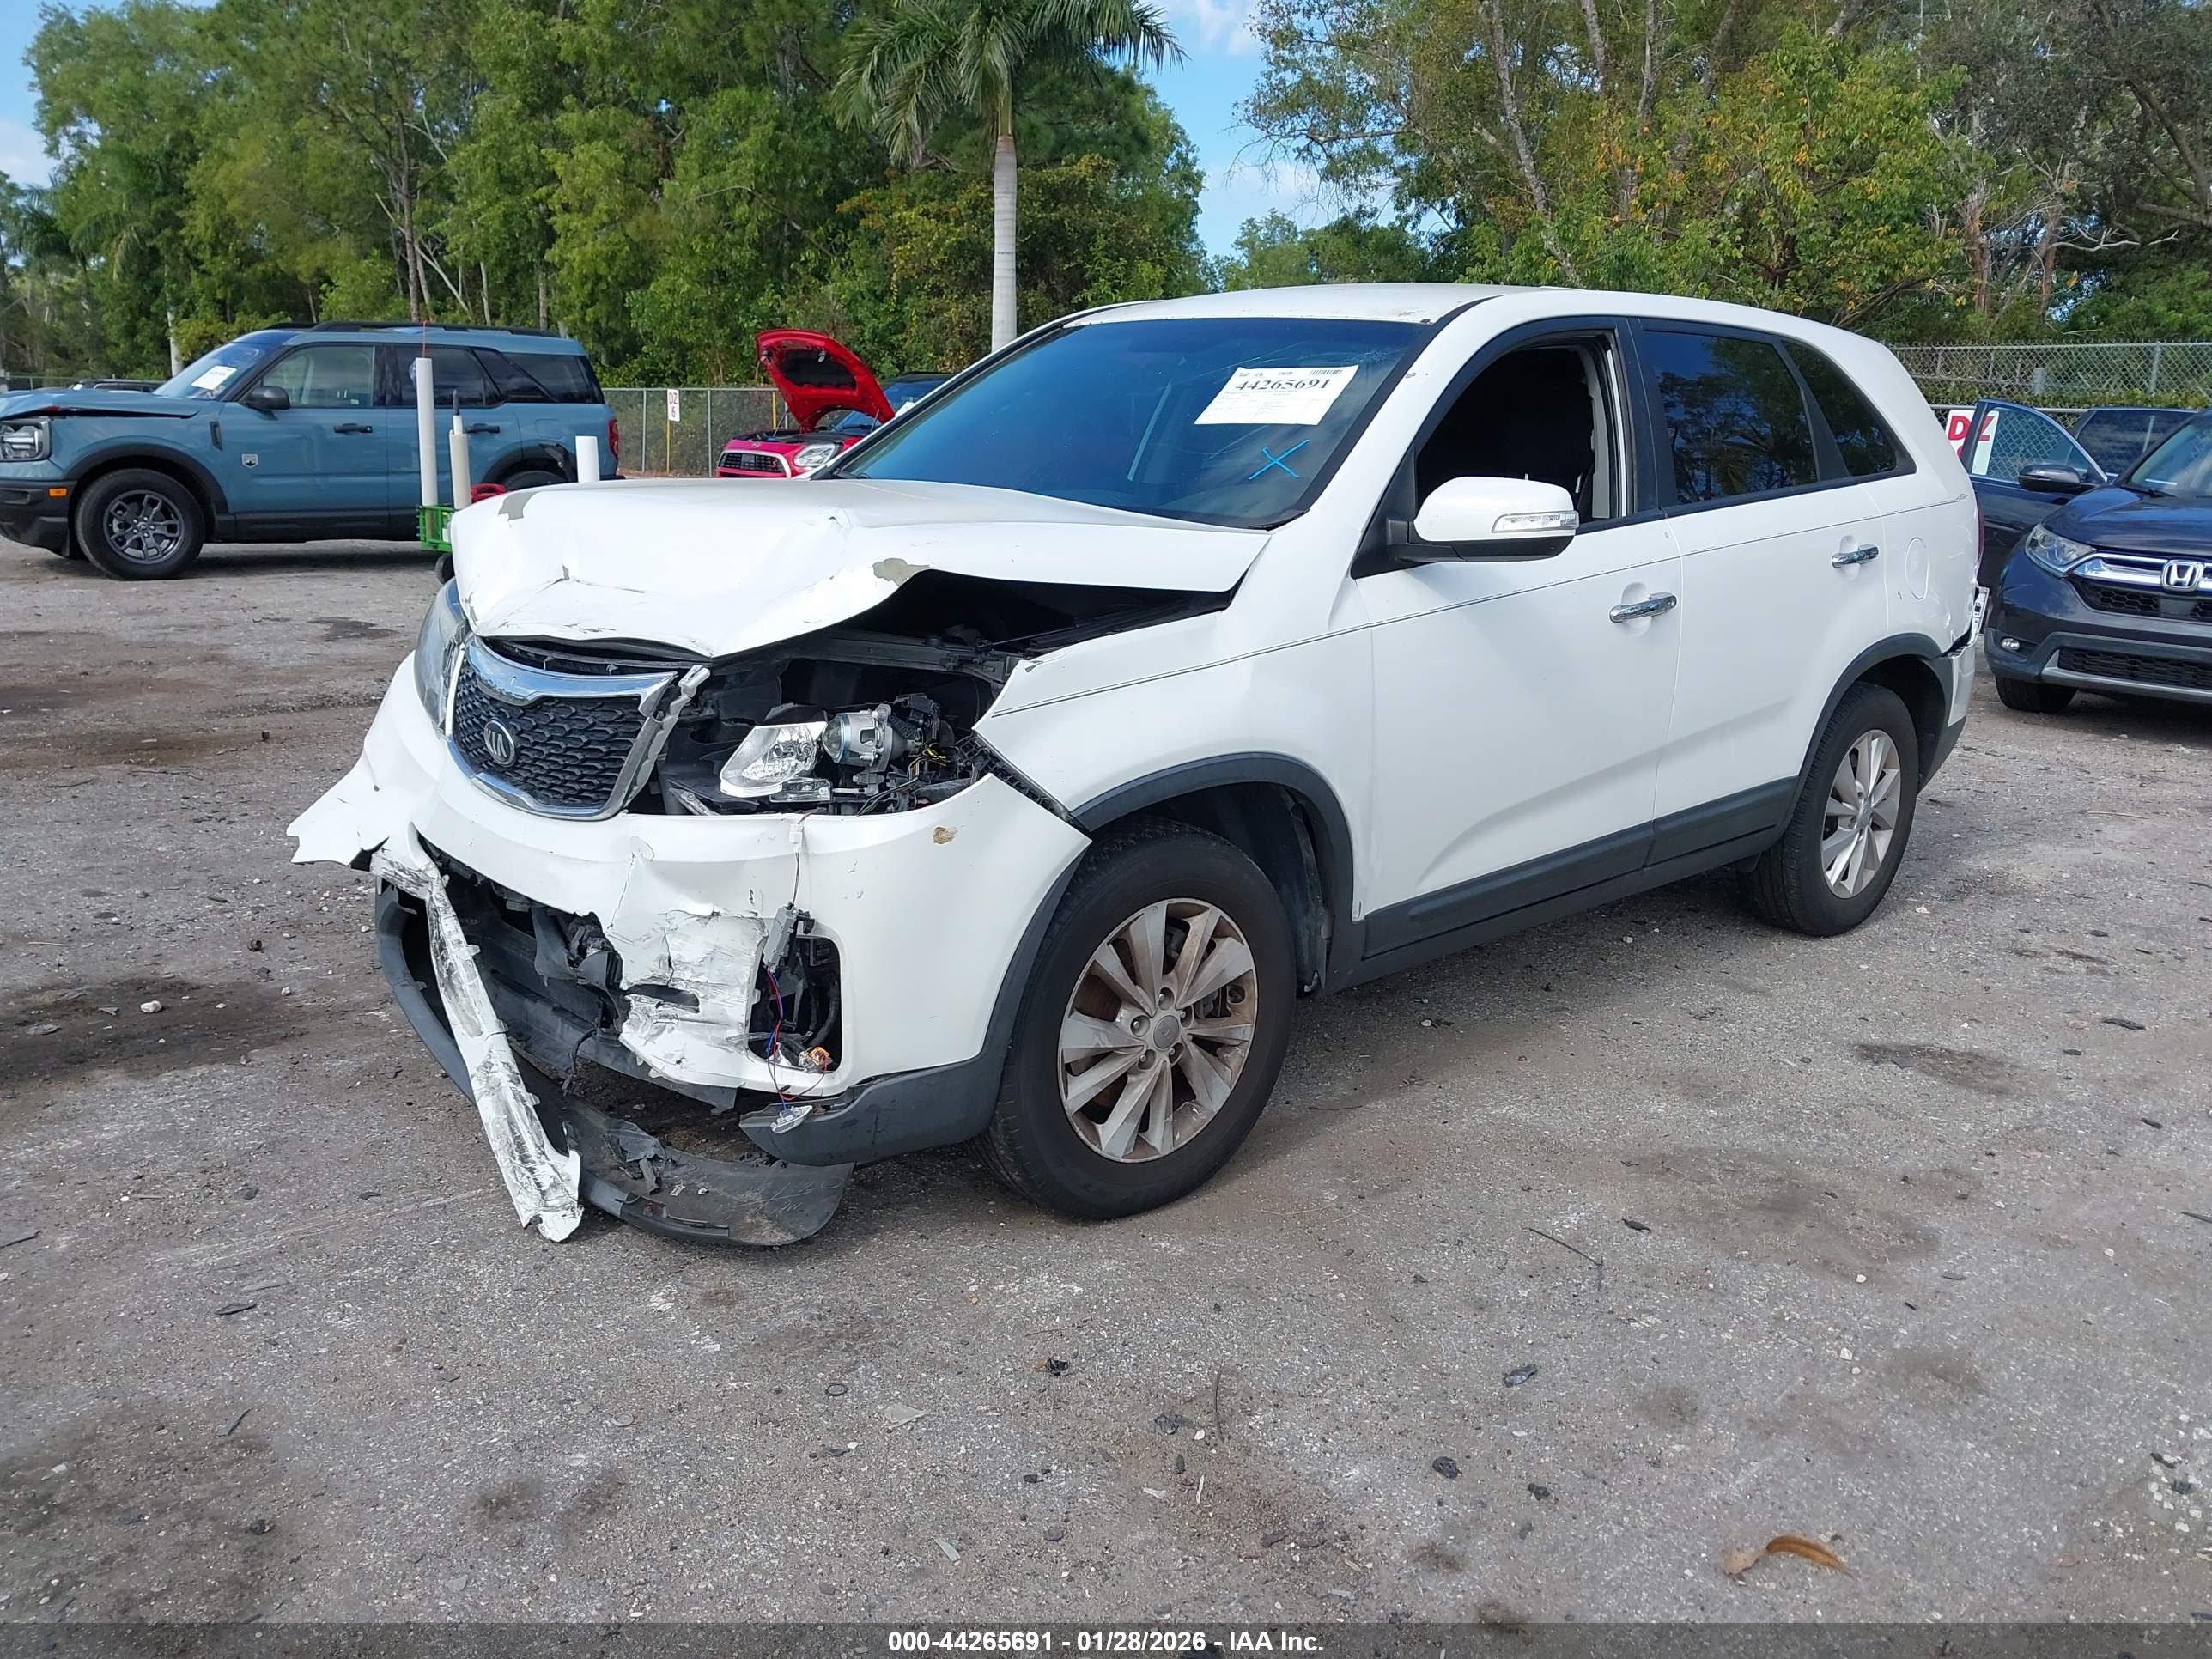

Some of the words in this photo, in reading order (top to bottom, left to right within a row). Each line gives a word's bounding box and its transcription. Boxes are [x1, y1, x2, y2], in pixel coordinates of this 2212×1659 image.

[1236, 378, 1331, 391] 44265691
[669, 392, 678, 404] DZ
[484, 726, 508, 758] KIA
